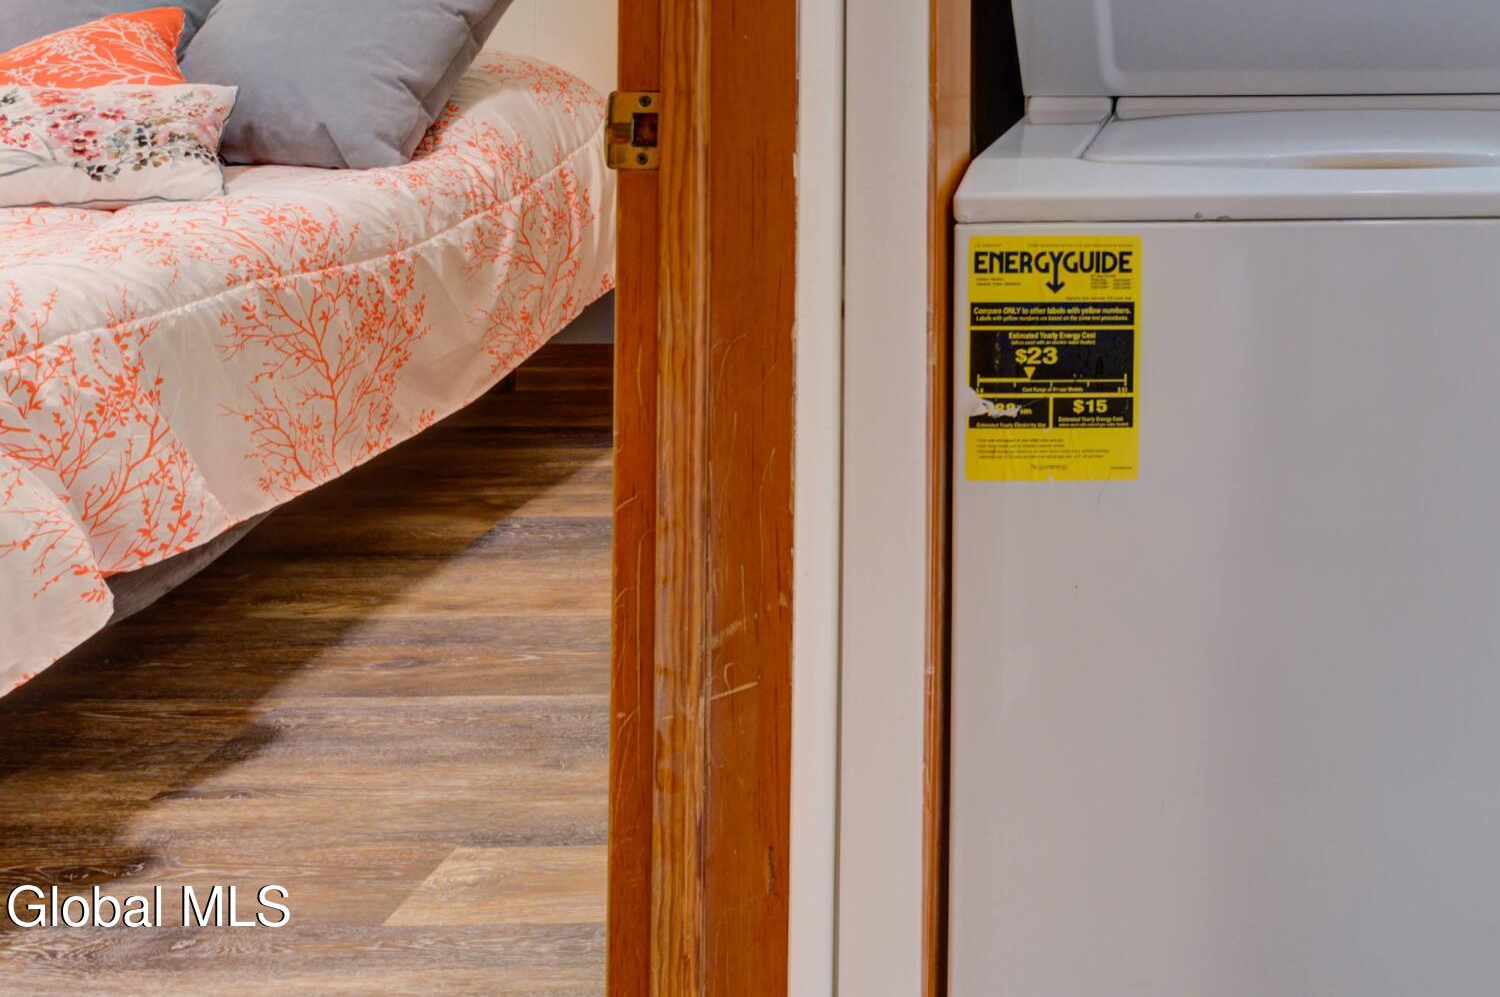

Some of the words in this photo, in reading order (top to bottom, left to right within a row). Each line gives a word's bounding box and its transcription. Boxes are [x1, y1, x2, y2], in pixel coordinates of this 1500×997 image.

[974, 251, 1133, 274] ENERGYGUIDE
[974, 306, 1001, 315] Compare
[1002, 307, 1020, 315] ONLY
[1022, 307, 1028, 315] to
[1029, 307, 1045, 315] other
[1046, 307, 1065, 315] labels
[1066, 307, 1079, 315] with
[1081, 307, 1100, 315] yellow
[1102, 307, 1131, 316] numbers.
[1009, 332, 1038, 340] Estimated
[1039, 332, 1057, 340] Yearly
[1059, 332, 1080, 340] Energy
[1081, 332, 1096, 340] Cost
[1015, 347, 1058, 365] $23
[1073, 399, 1108, 414] $15
